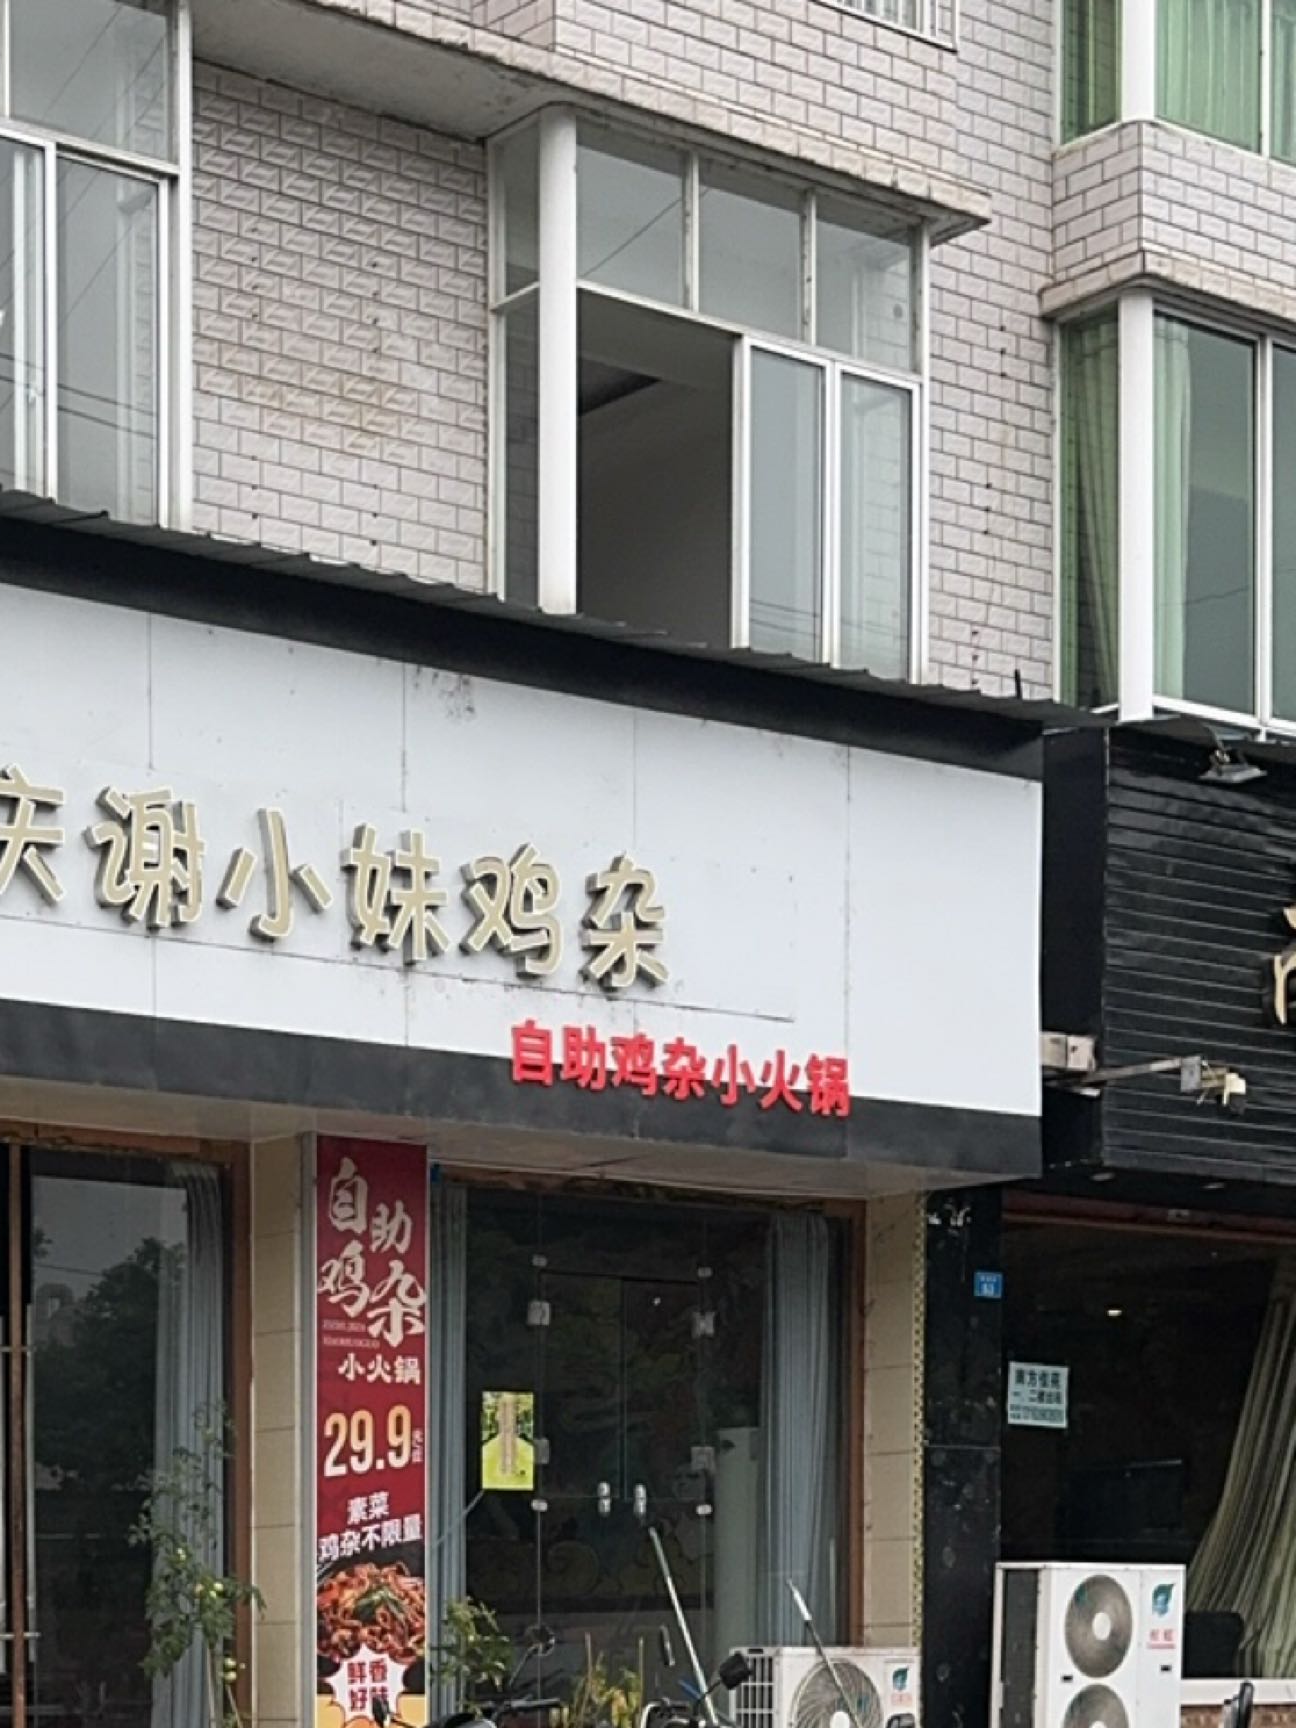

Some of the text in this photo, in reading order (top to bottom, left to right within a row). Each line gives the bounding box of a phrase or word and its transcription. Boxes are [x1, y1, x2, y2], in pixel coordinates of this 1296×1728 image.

[511, 1019, 851, 1117] 自助鸡杂小火锅
[329, 1156, 412, 1254] 自助
[317, 1240, 426, 1347] 鸡杂
[338, 1353, 421, 1385] 小火锅
[323, 1404, 412, 1477] 29.9
[318, 1513, 423, 1562] 鸡杂不限量
[347, 1491, 390, 1526] 素菜
